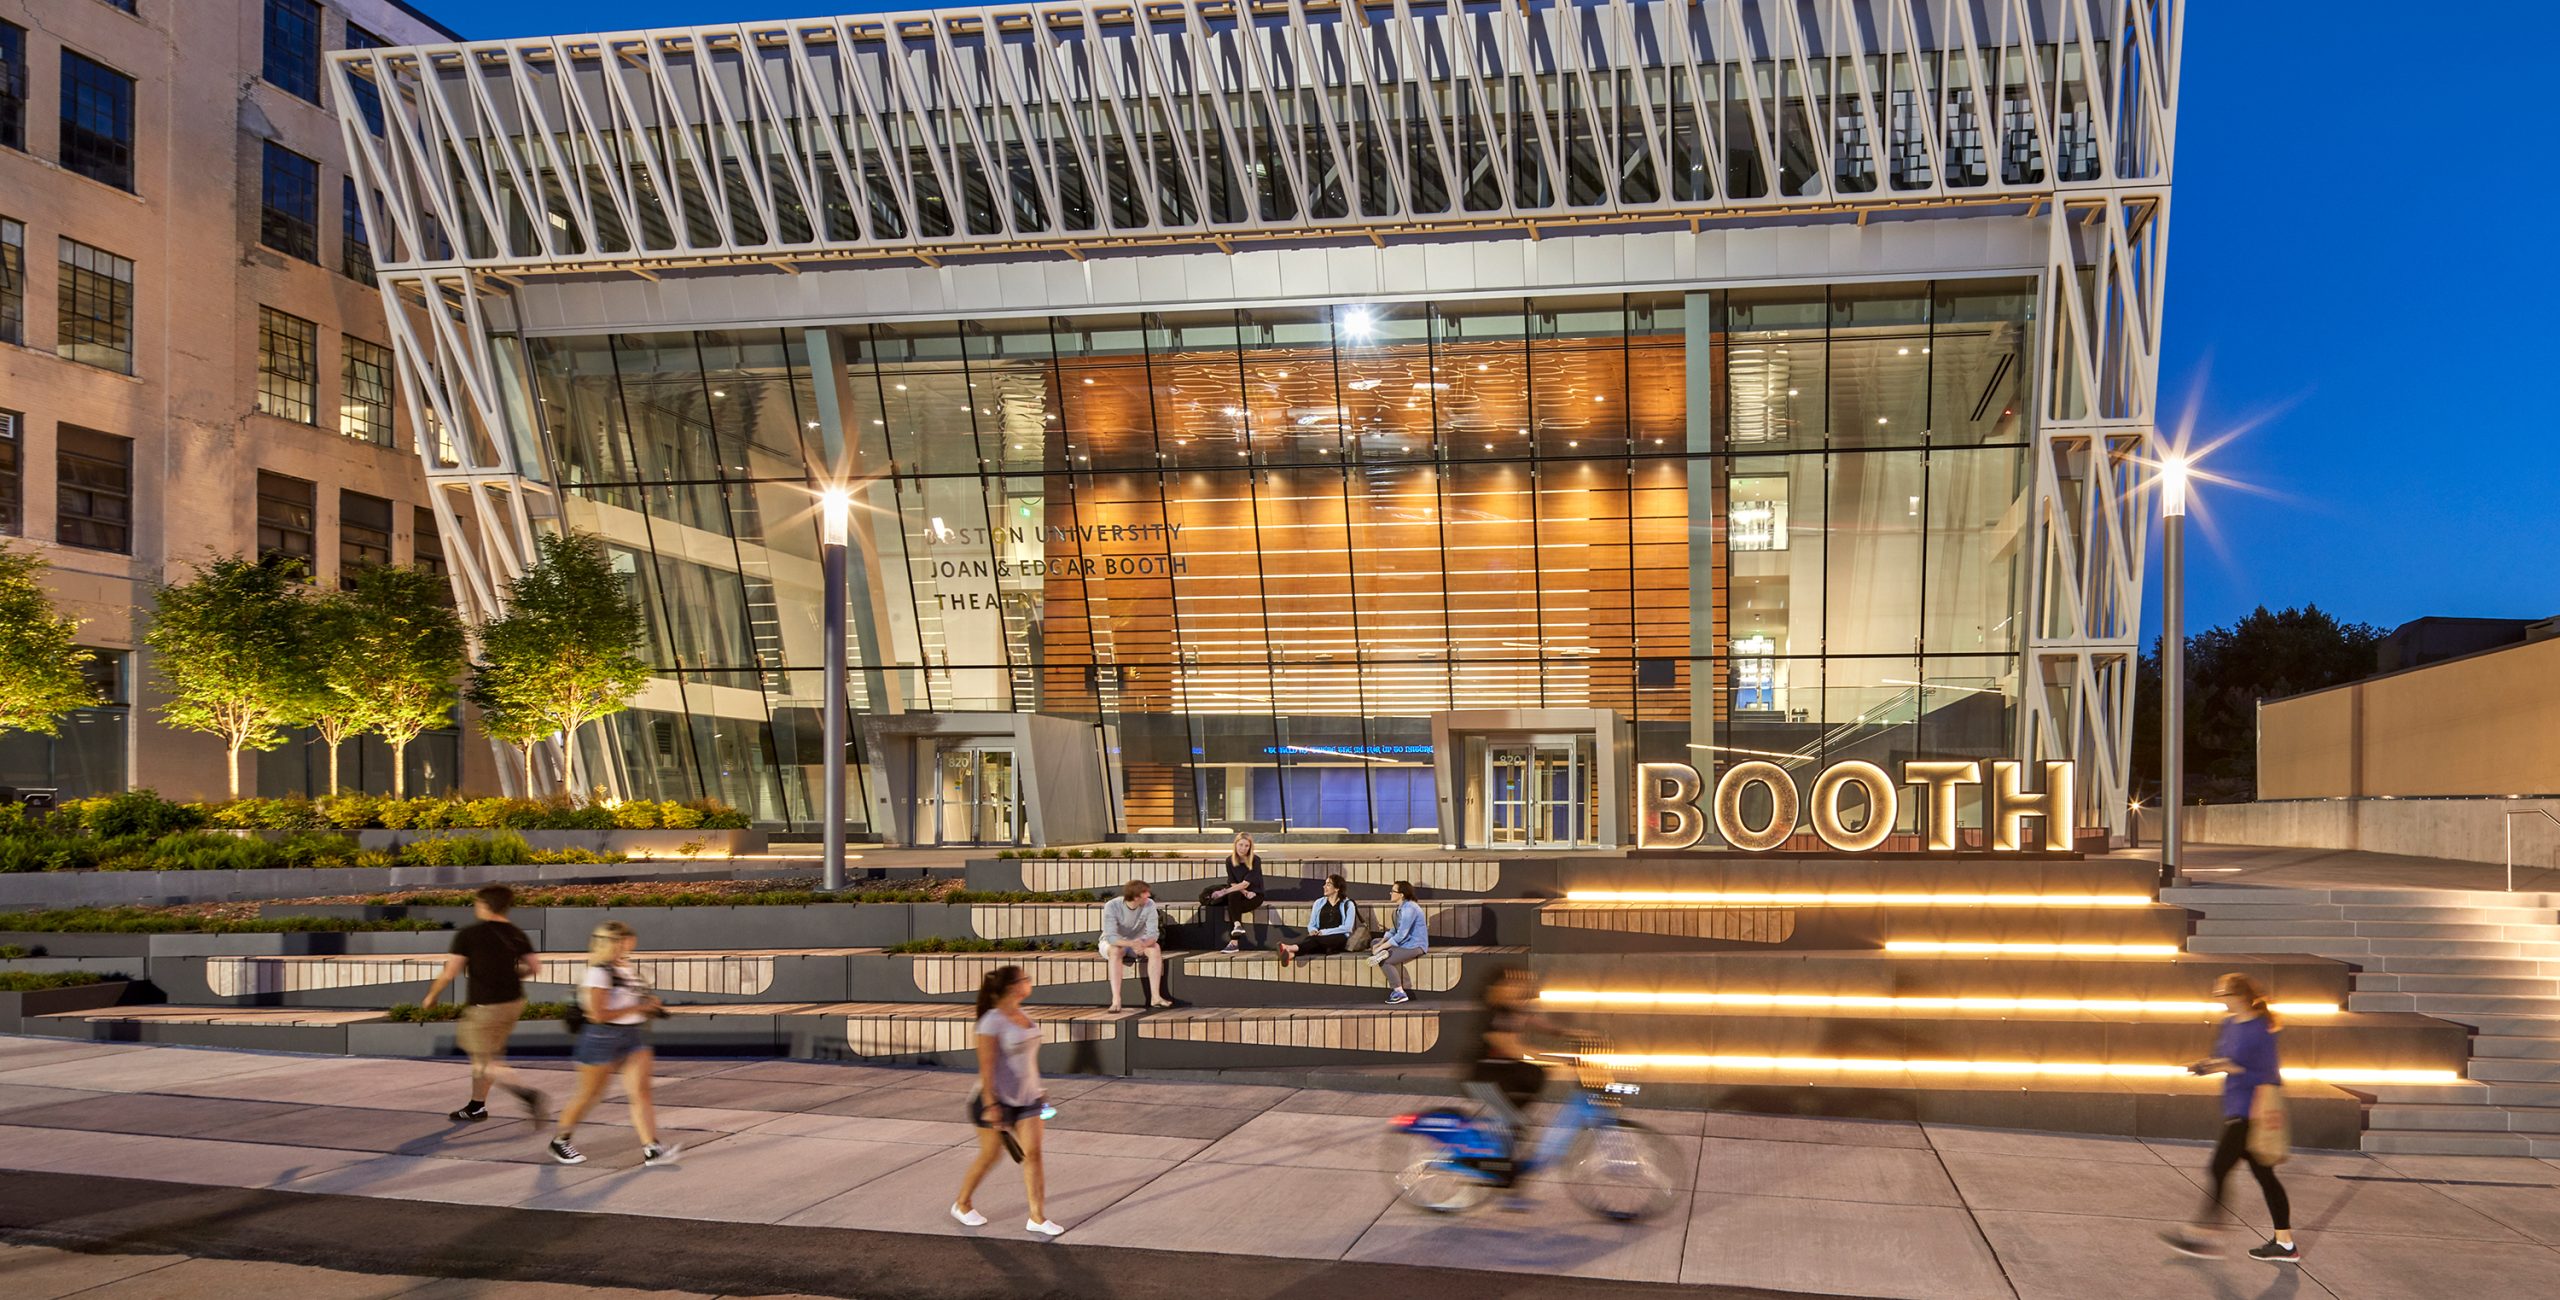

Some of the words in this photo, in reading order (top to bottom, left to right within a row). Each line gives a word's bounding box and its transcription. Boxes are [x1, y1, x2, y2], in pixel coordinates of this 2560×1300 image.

[924, 526, 1024, 545] BOSTON
[1036, 523, 1183, 543] UNIVERSITY
[931, 560, 989, 578] JOAN
[997, 560, 1011, 577] &
[1021, 557, 1096, 576] EDGAR
[1106, 556, 1188, 575] BOOTH
[948, 757, 969, 768] 820
[1499, 755, 1522, 766] 820
[1636, 760, 2076, 852] BOOTH
